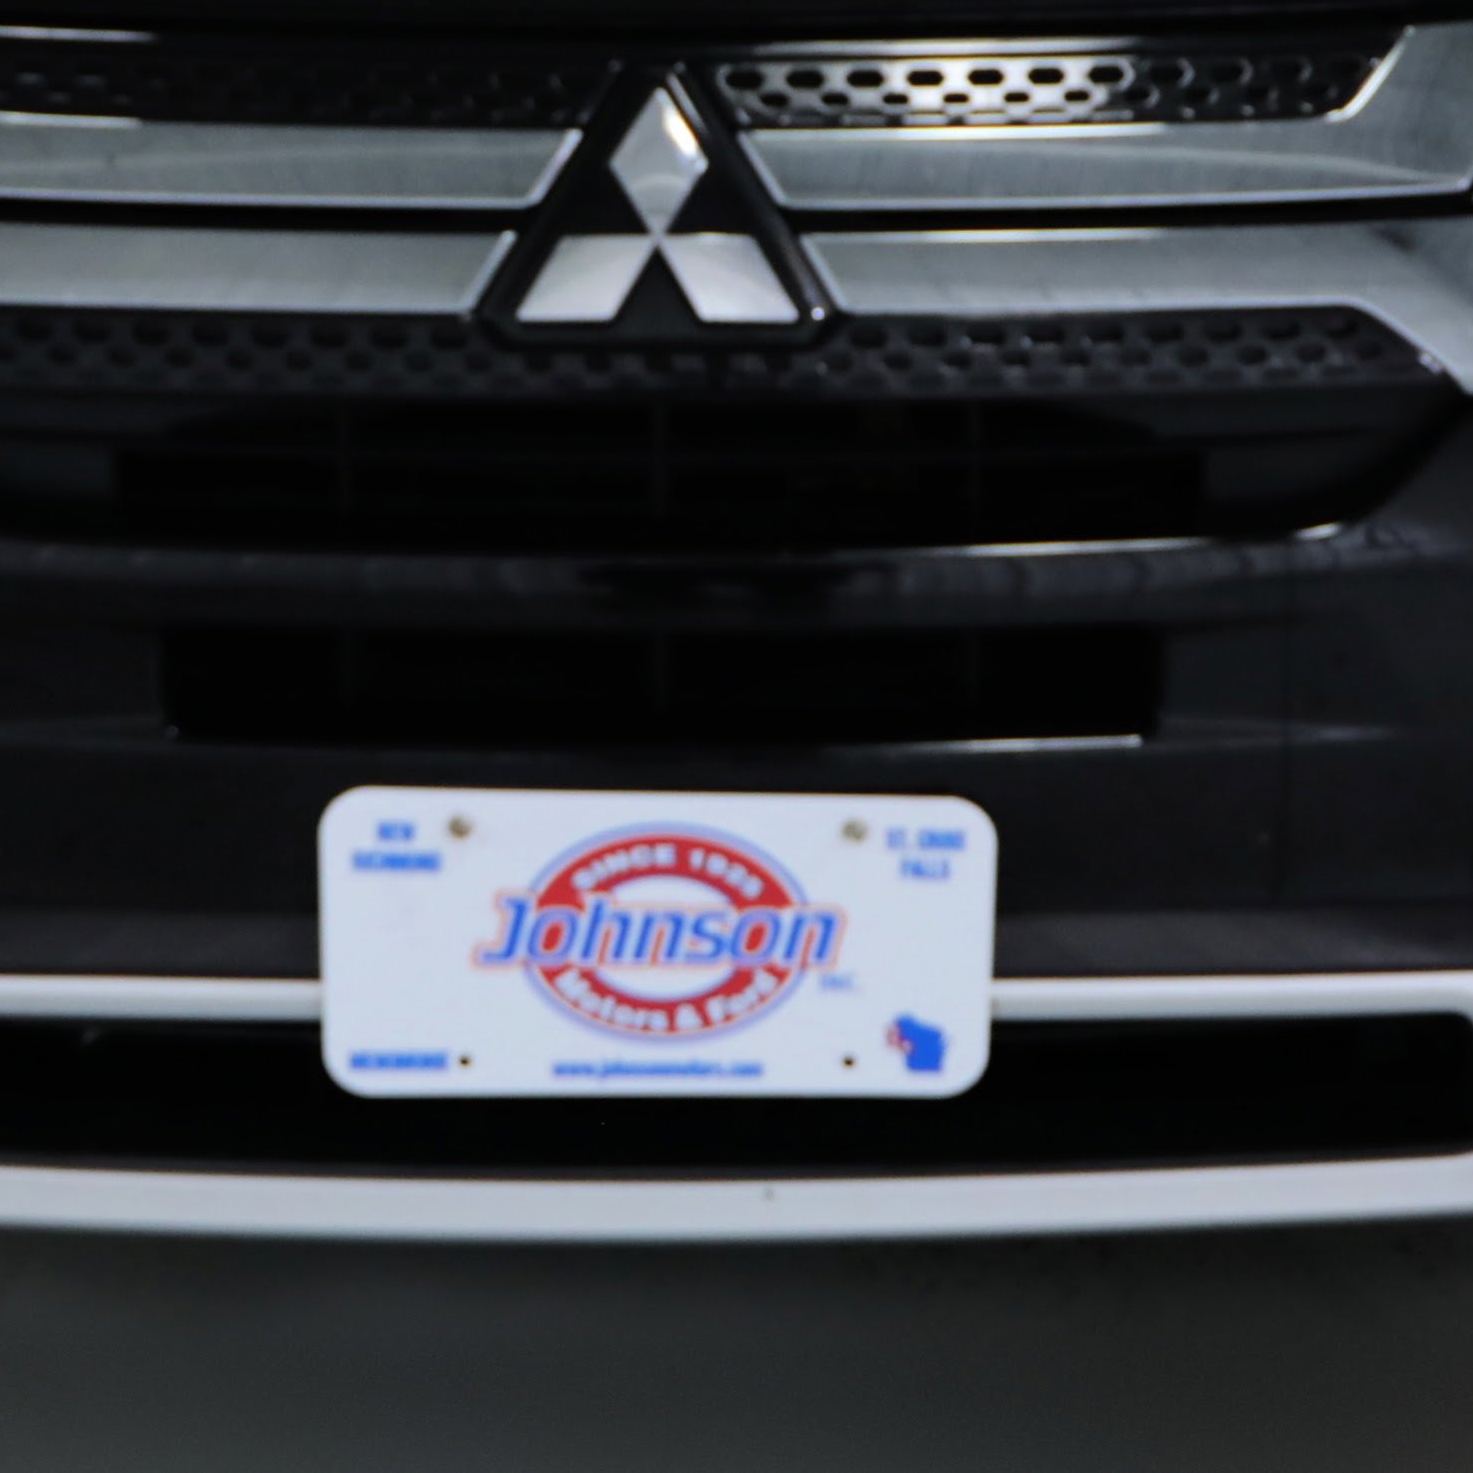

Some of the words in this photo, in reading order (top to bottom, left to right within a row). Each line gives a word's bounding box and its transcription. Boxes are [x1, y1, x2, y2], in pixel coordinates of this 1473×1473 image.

[572, 843, 677, 891] SINCE
[478, 892, 838, 966] Johnson
[553, 968, 668, 1030] Motors
